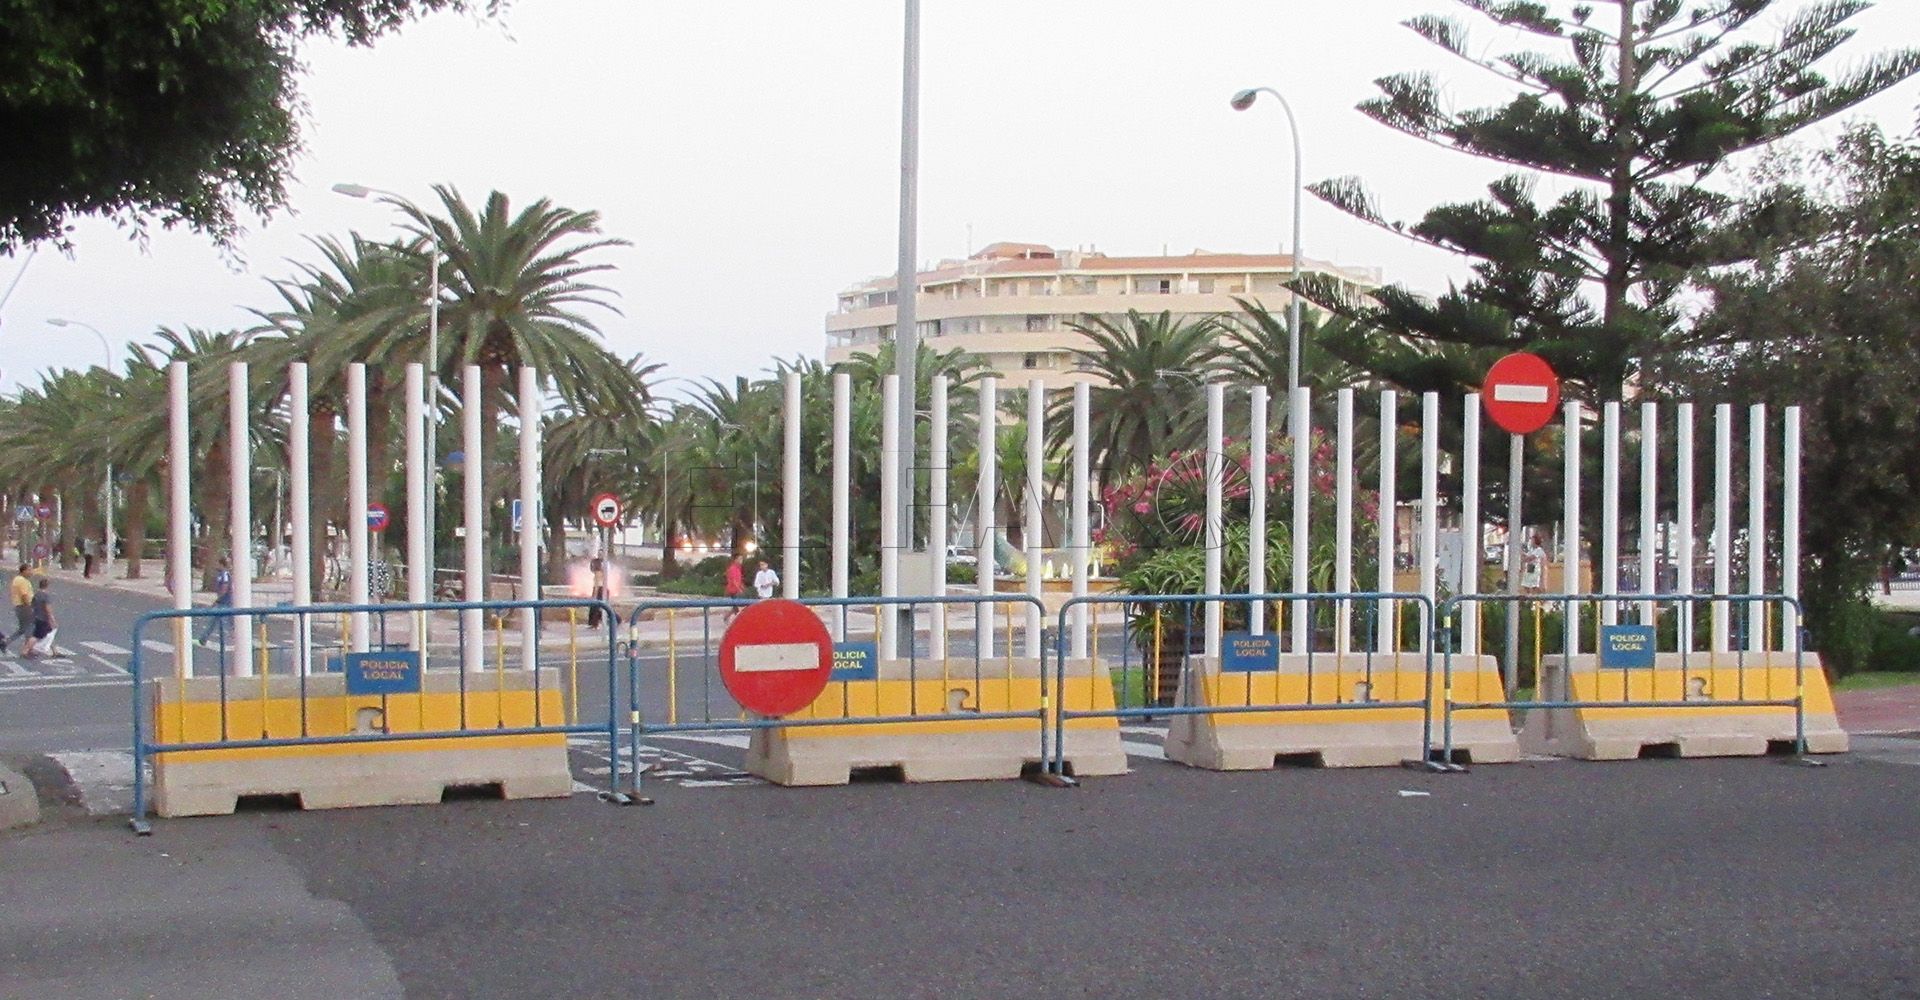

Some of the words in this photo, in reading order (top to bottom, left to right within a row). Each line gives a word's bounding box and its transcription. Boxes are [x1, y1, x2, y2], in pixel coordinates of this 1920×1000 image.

[1609, 634, 1647, 642] POLICIA
[1233, 640, 1271, 648] POLICIA
[1612, 643, 1643, 651] LOCAL
[832, 650, 867, 660] OLICIA
[1236, 649, 1267, 657] LOCAL
[360, 660, 409, 670] POLICIA
[363, 671, 404, 680] LOCAL
